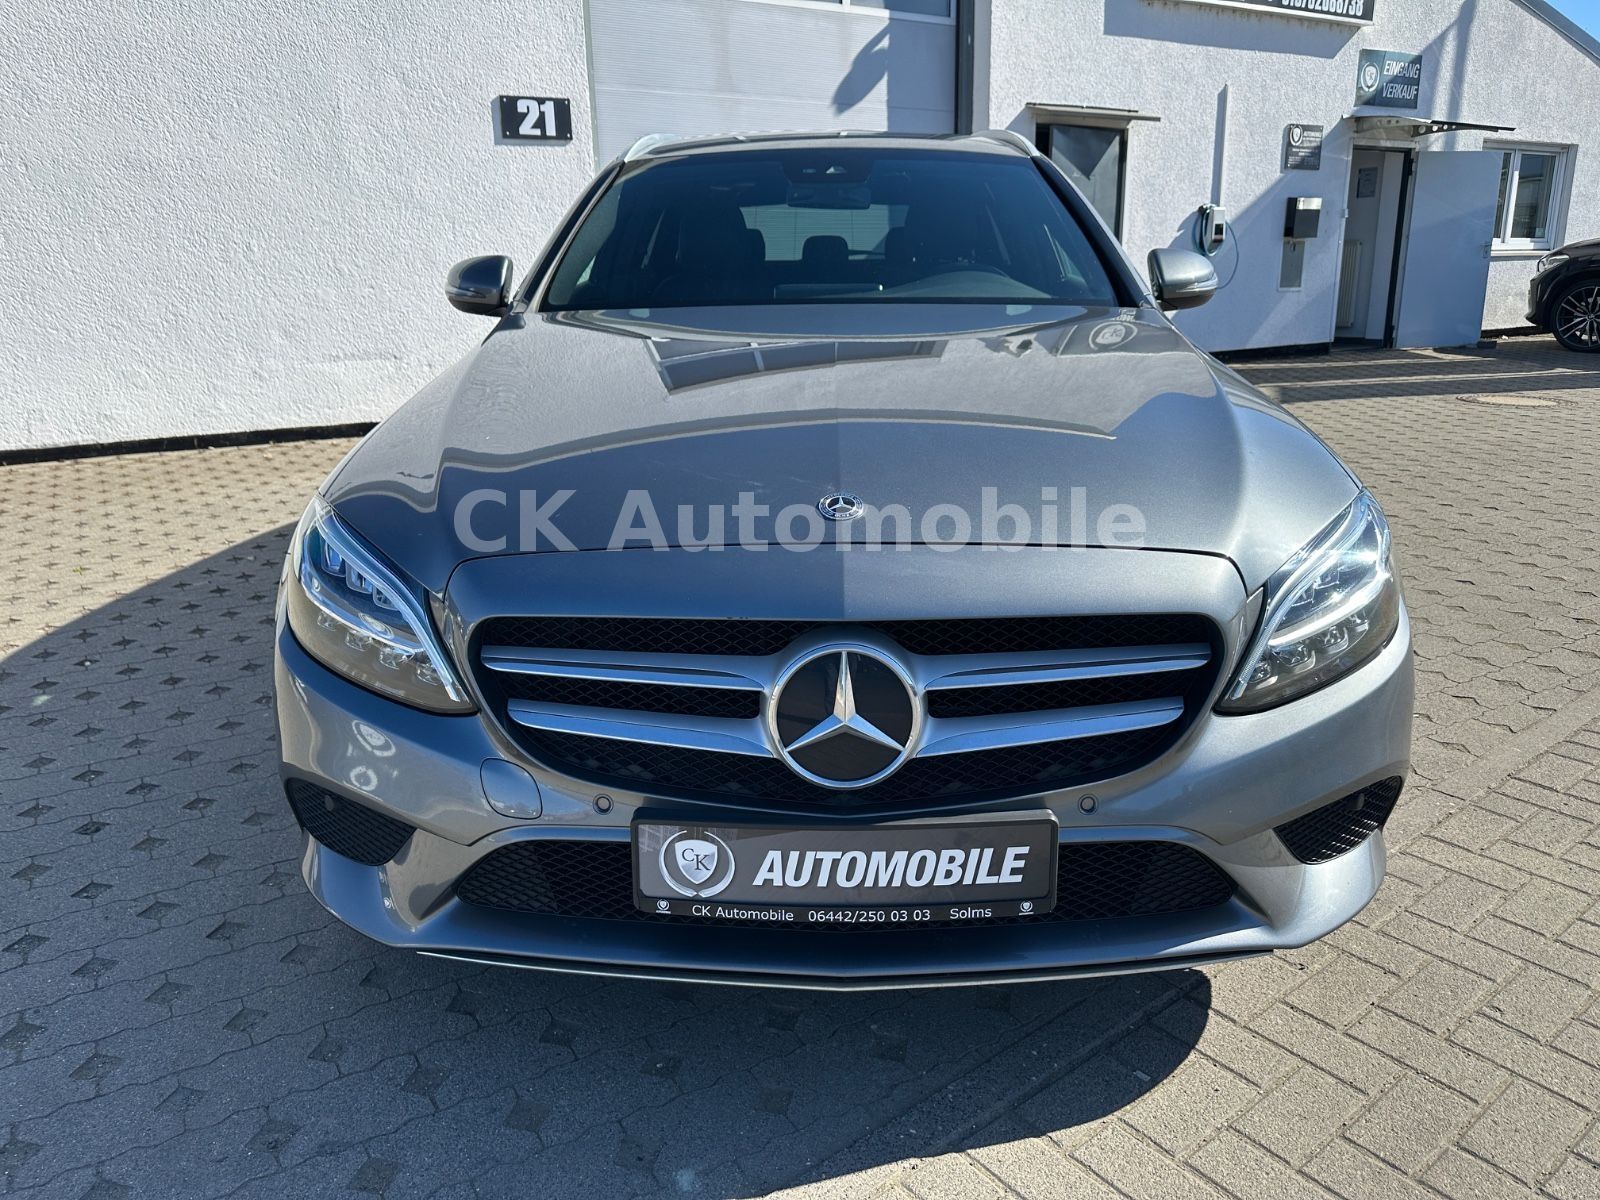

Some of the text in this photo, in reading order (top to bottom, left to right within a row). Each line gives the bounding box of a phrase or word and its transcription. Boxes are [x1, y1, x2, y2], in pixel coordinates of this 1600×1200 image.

[1384, 60, 1420, 79] EINGANG
[1382, 82, 1418, 100] VERKAUF
[517, 98, 557, 136] 21
[681, 847, 711, 871] CK
[753, 846, 1030, 888] AUTOMOBILE
[692, 904, 992, 923] CK Automobile 06442/250 03 03 Solms
